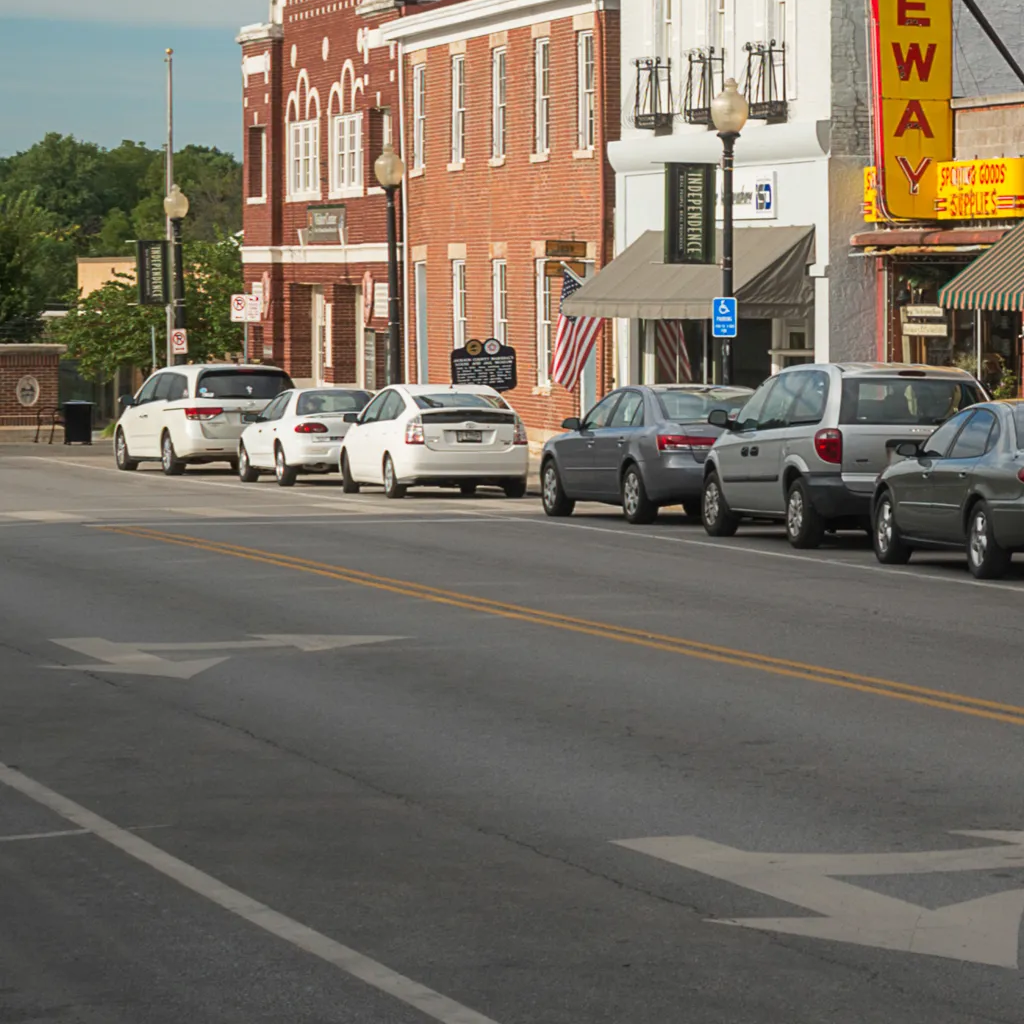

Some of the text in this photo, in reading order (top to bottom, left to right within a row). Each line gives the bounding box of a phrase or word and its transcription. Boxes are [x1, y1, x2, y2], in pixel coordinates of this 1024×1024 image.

[980, 162, 1007, 185] GOODS
[687, 173, 702, 254] INDEPENDENCE
[950, 189, 998, 217] SUPPLIES
[150, 245, 163, 298] INDEPENDENCE
